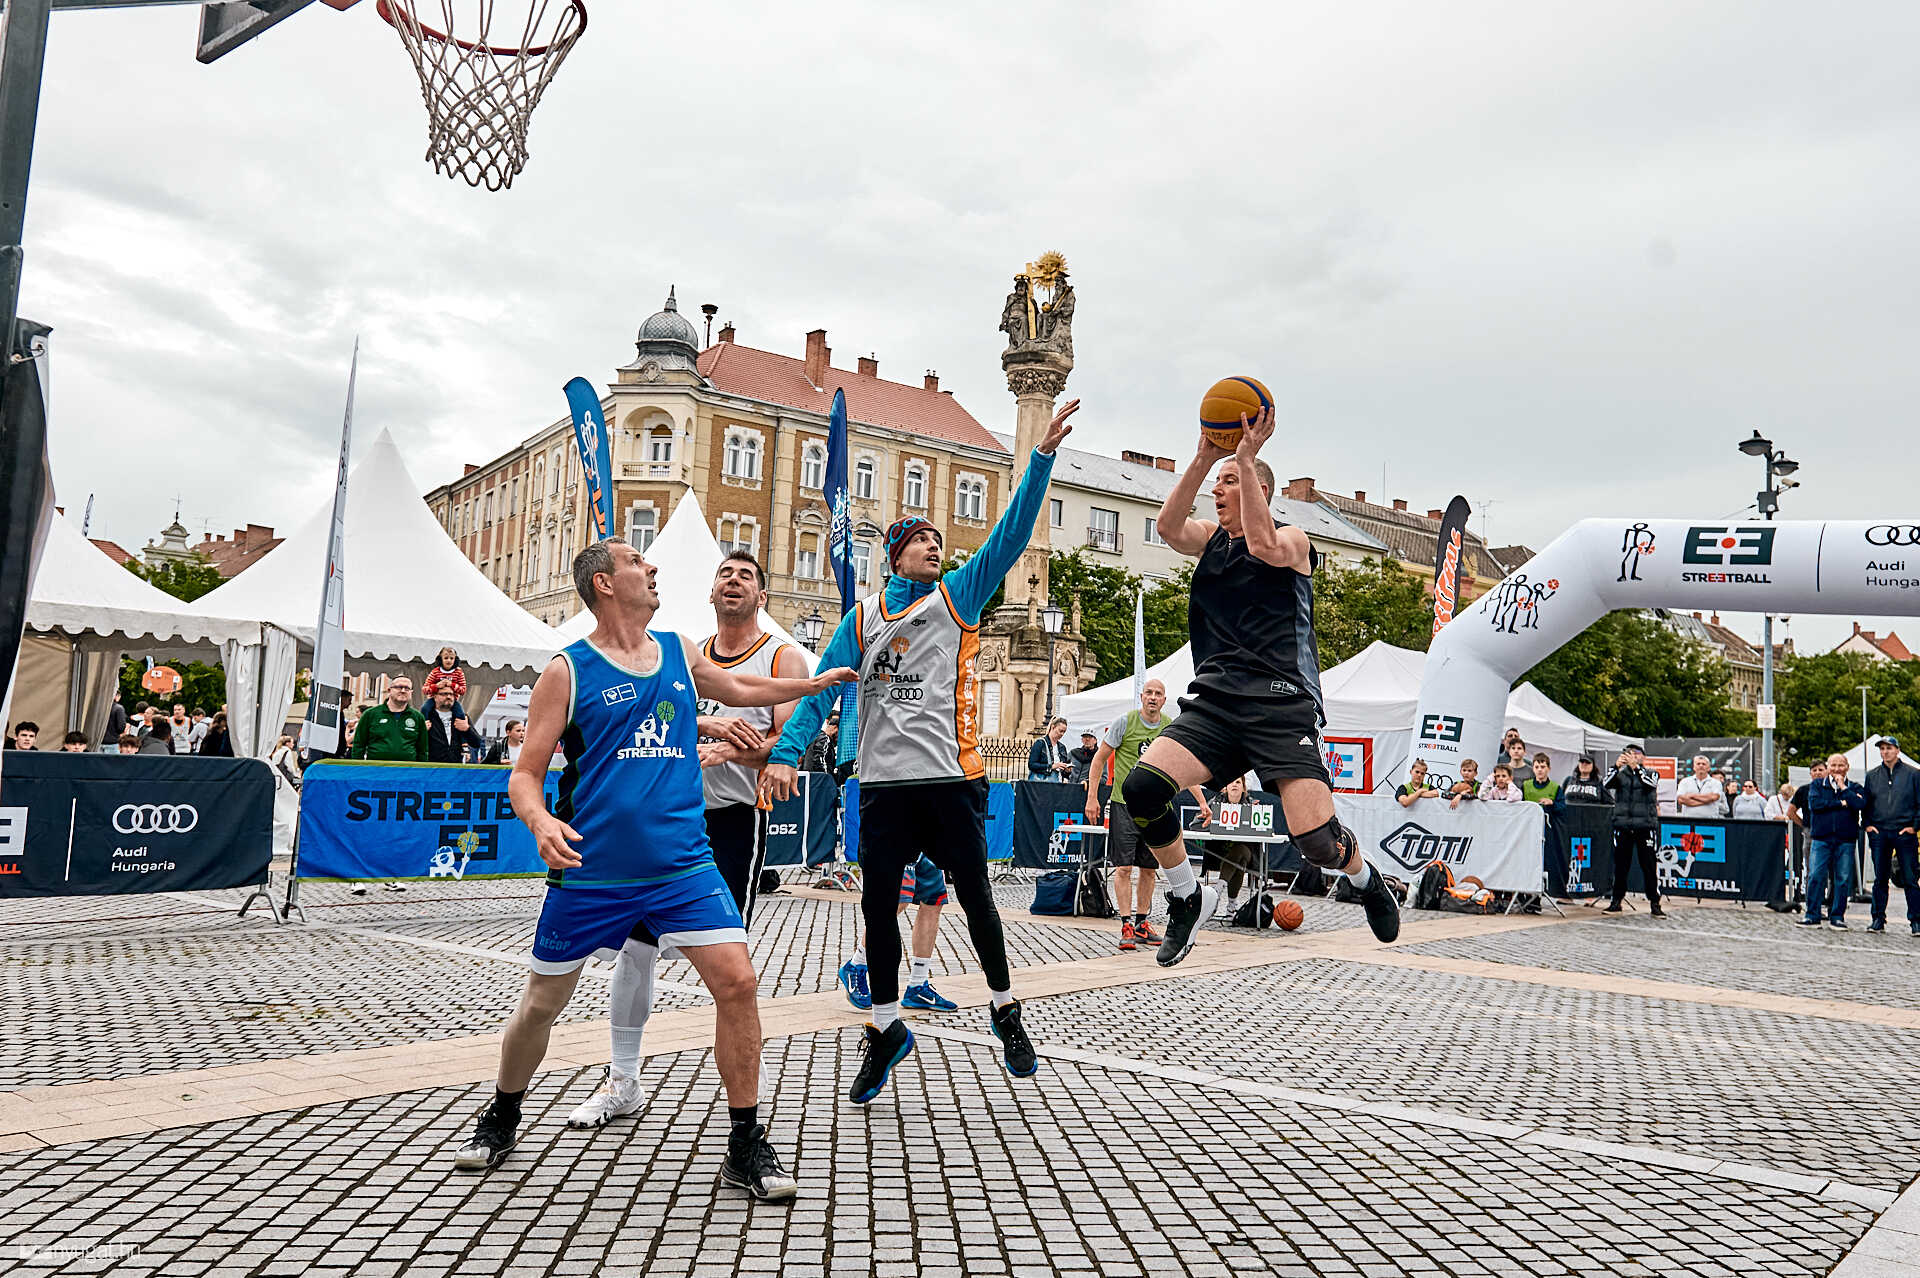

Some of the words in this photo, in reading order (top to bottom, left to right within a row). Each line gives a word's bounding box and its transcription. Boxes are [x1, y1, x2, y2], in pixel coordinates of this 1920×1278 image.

[1865, 560, 1905, 571] Audi
[1682, 572, 1772, 584] STREETBALL
[617, 746, 686, 760] STREETBALL
[1418, 743, 1459, 753] STREETBALL
[1220, 810, 1240, 826] 00
[1252, 811, 1272, 827] 05
[766, 823, 798, 835] OSZ
[112, 847, 148, 857] Audi
[1401, 834, 1473, 864] TOTI
[111, 861, 176, 873] Hungaria
